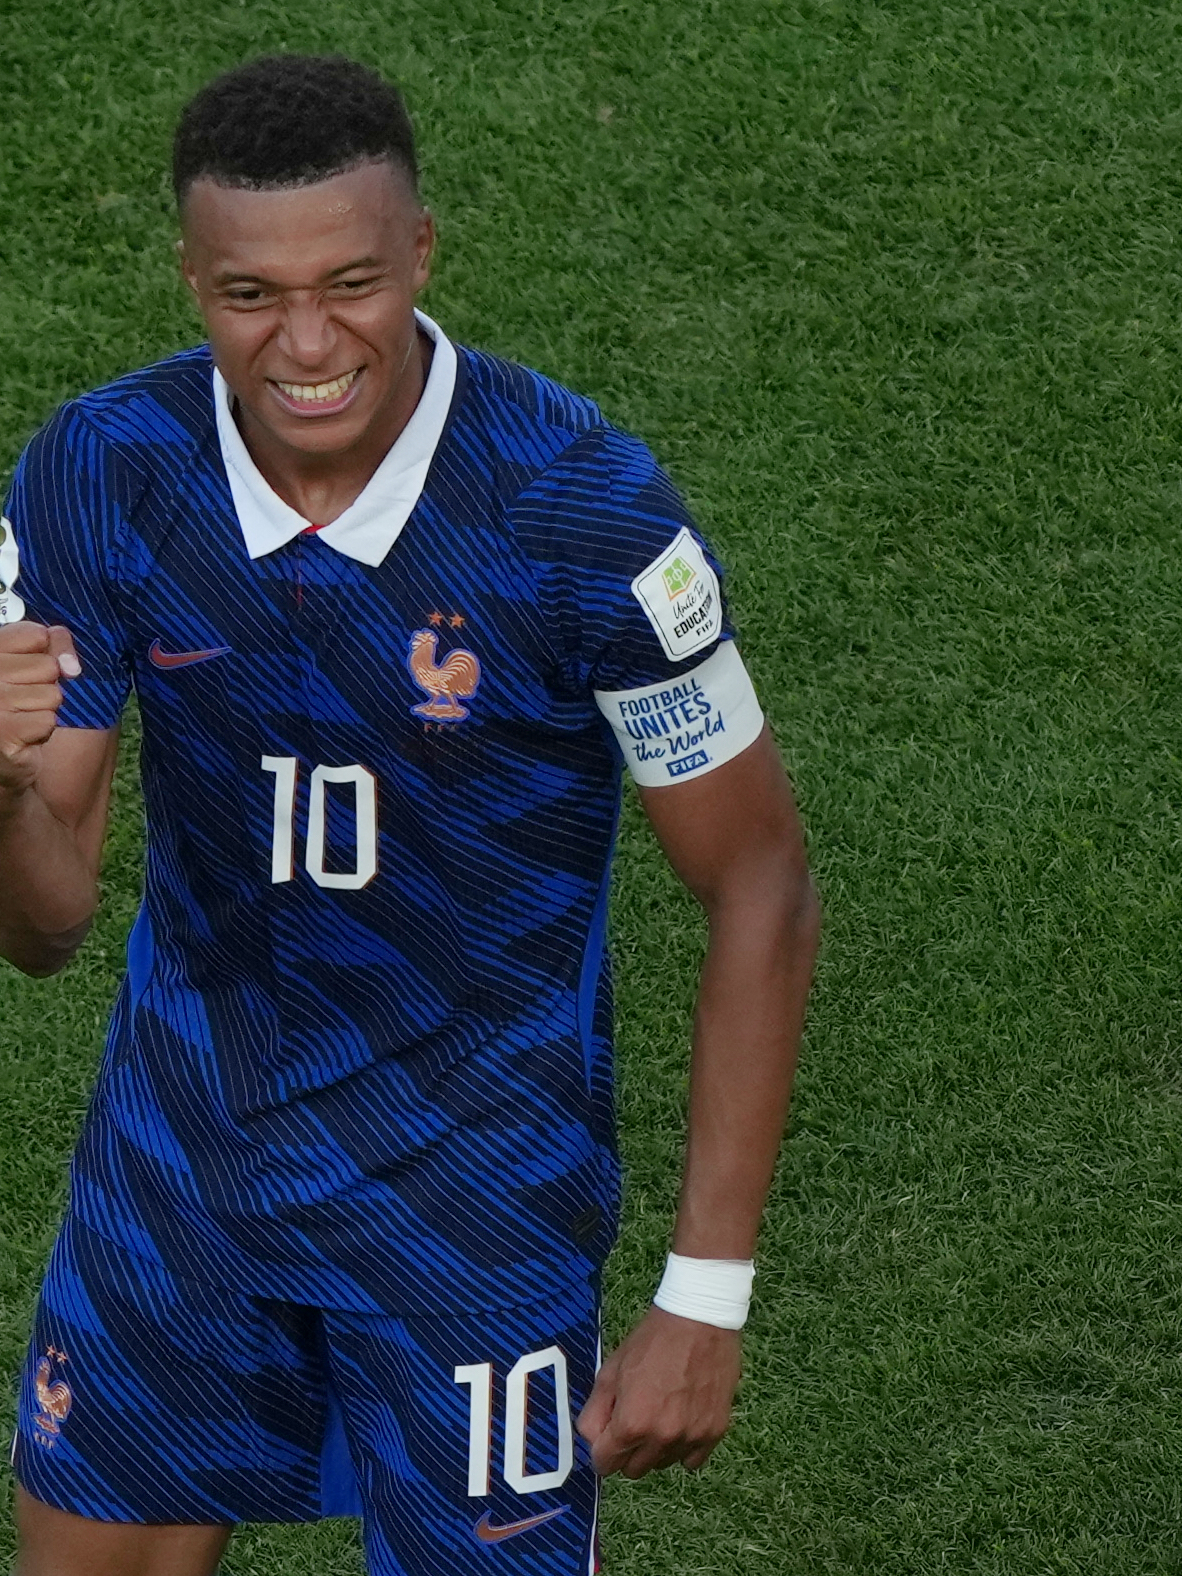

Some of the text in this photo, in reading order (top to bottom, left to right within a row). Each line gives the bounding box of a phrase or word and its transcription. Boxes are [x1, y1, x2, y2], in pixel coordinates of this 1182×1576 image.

[618, 678, 702, 718] FOOTBALL
[624, 691, 712, 740] UNITES
[632, 710, 726, 762] the World
[669, 753, 707, 775] FIFA
[261, 755, 379, 890] 10
[454, 1345, 573, 1497] 10
